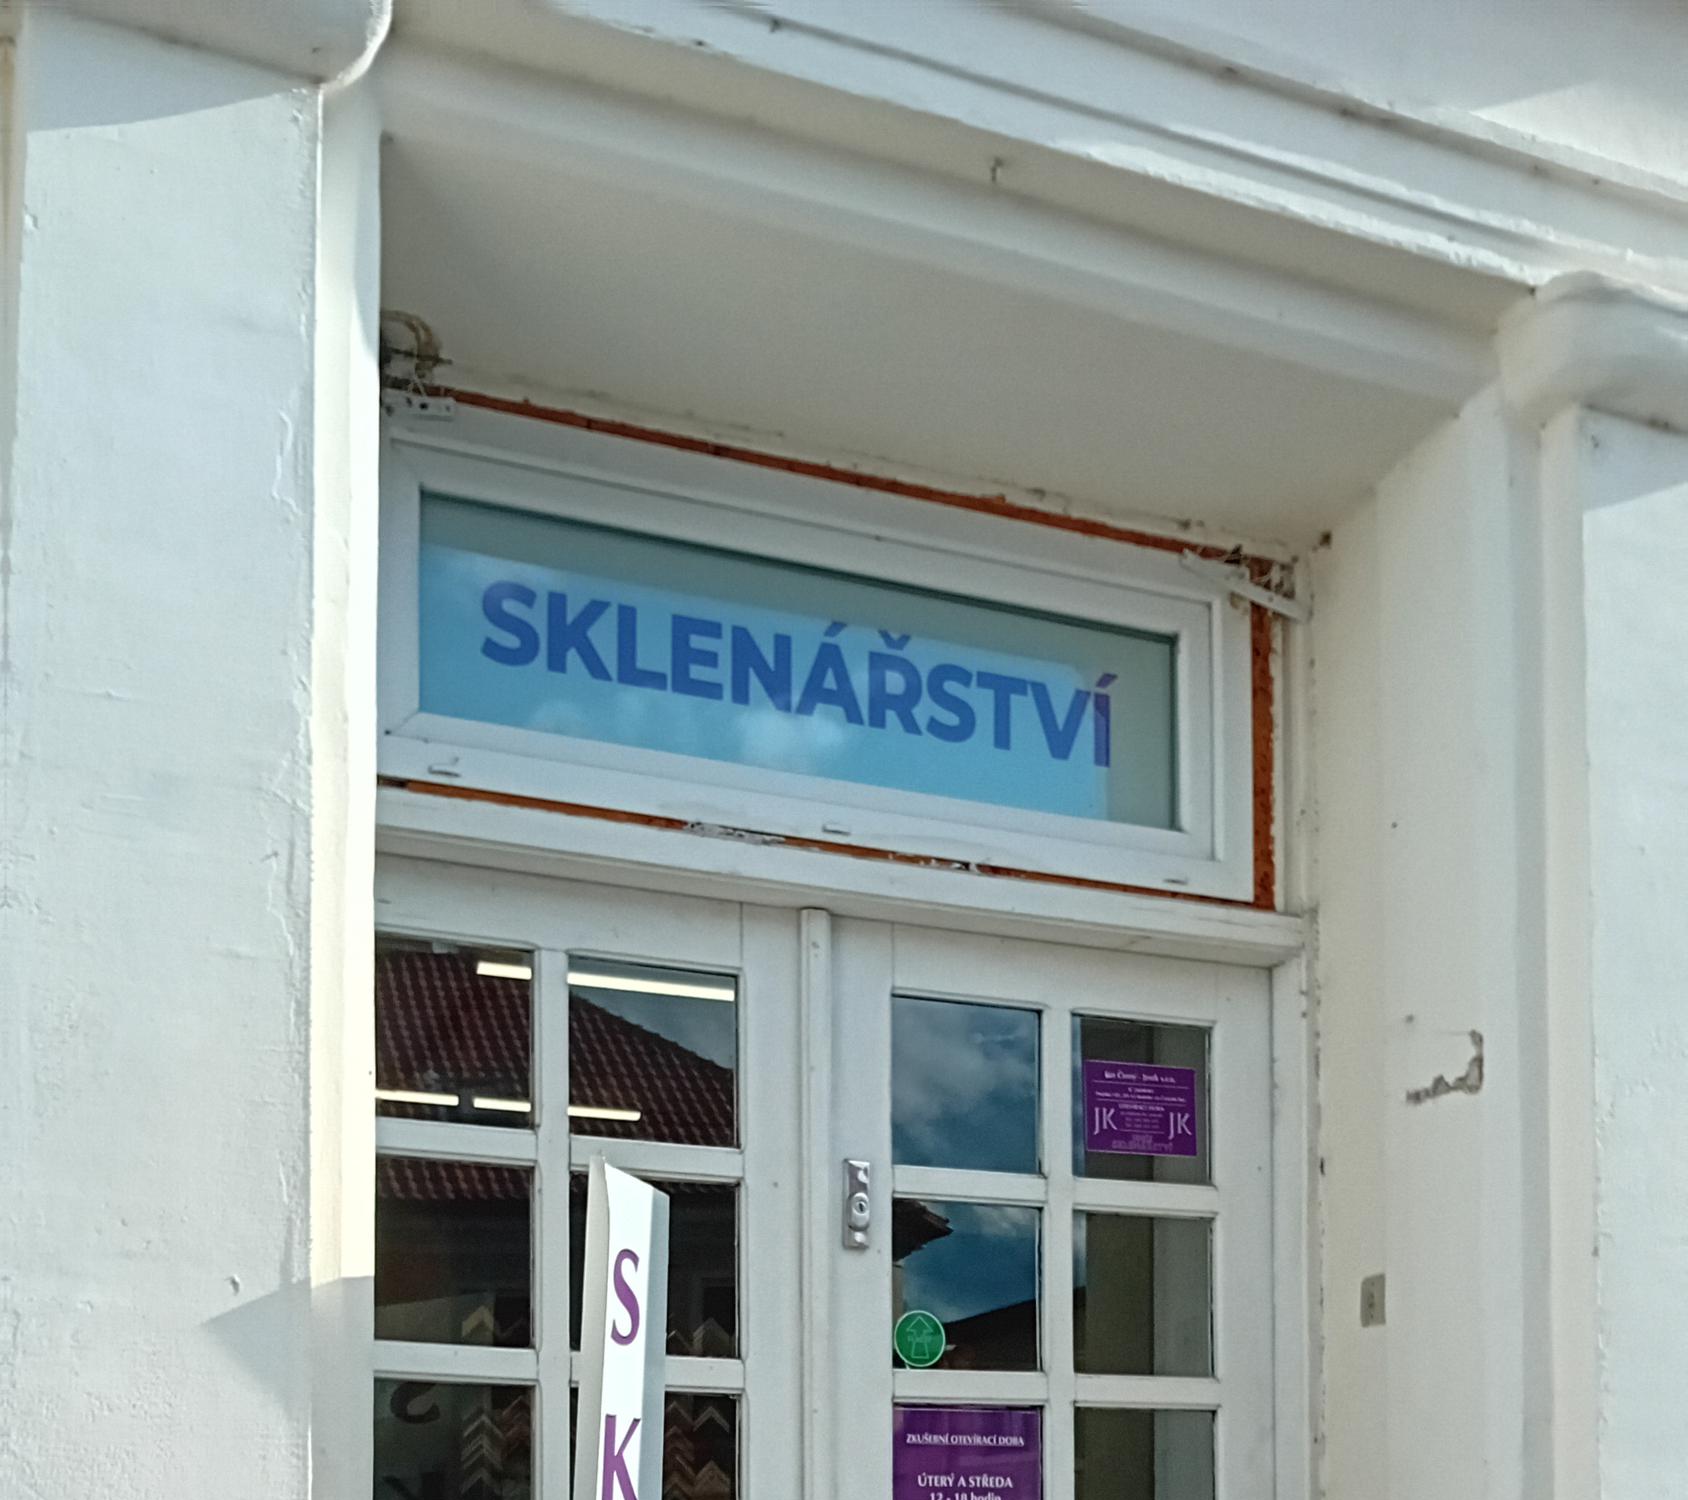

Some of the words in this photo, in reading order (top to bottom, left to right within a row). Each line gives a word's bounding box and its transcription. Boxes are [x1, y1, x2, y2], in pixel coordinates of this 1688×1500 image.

[481, 580, 1119, 768] SKLENÁŘSTVÍ
[1094, 1107, 1118, 1135] JK
[1168, 1111, 1192, 1140] JK
[950, 1433, 997, 1446] OTEVÍRACÍ
[998, 1436, 1025, 1447] DOBA
[917, 1472, 955, 1488] ÚTERÝ
[957, 1475, 967, 1488] A
[968, 1473, 1014, 1489] STŘEDA
